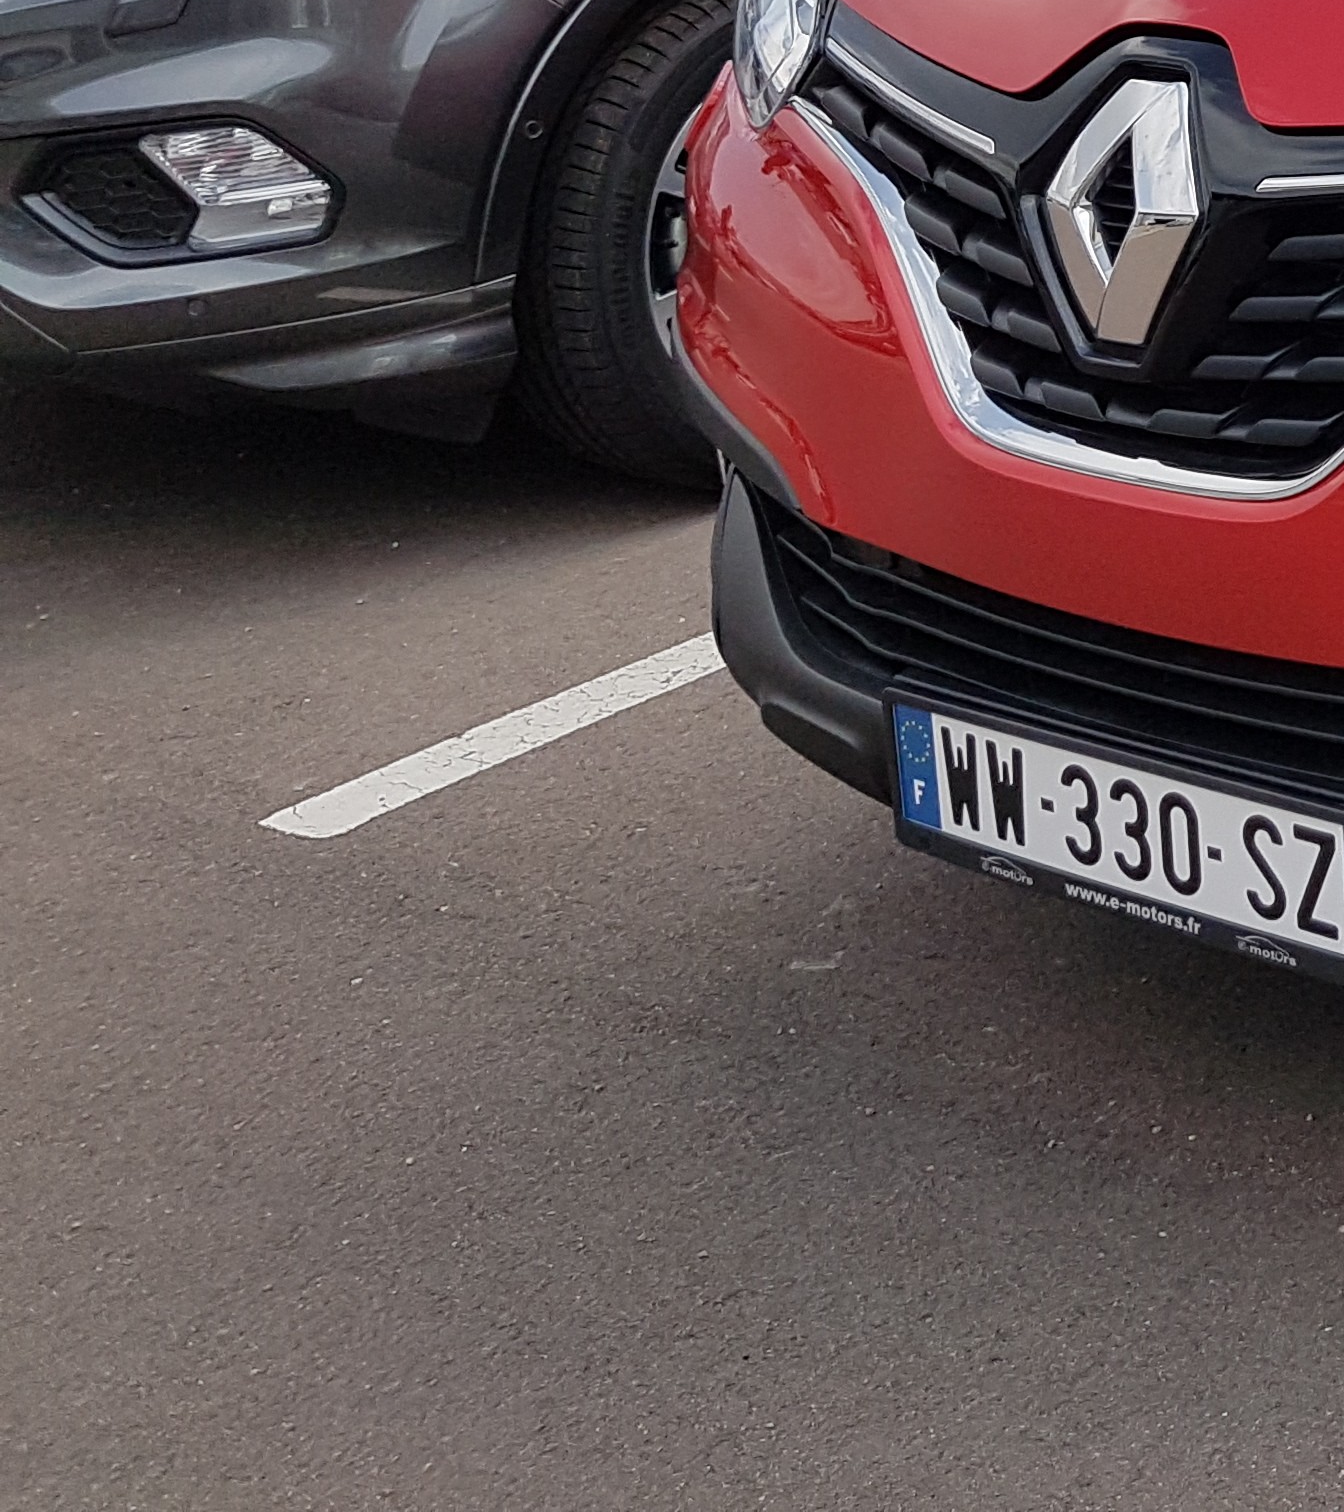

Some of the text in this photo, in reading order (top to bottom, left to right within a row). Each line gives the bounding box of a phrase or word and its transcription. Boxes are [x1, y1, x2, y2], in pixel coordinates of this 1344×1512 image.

[913, 778, 925, 805] F
[940, 725, 1339, 941] WW-330-SZ
[1064, 883, 1202, 935] www.e-motors.fr
